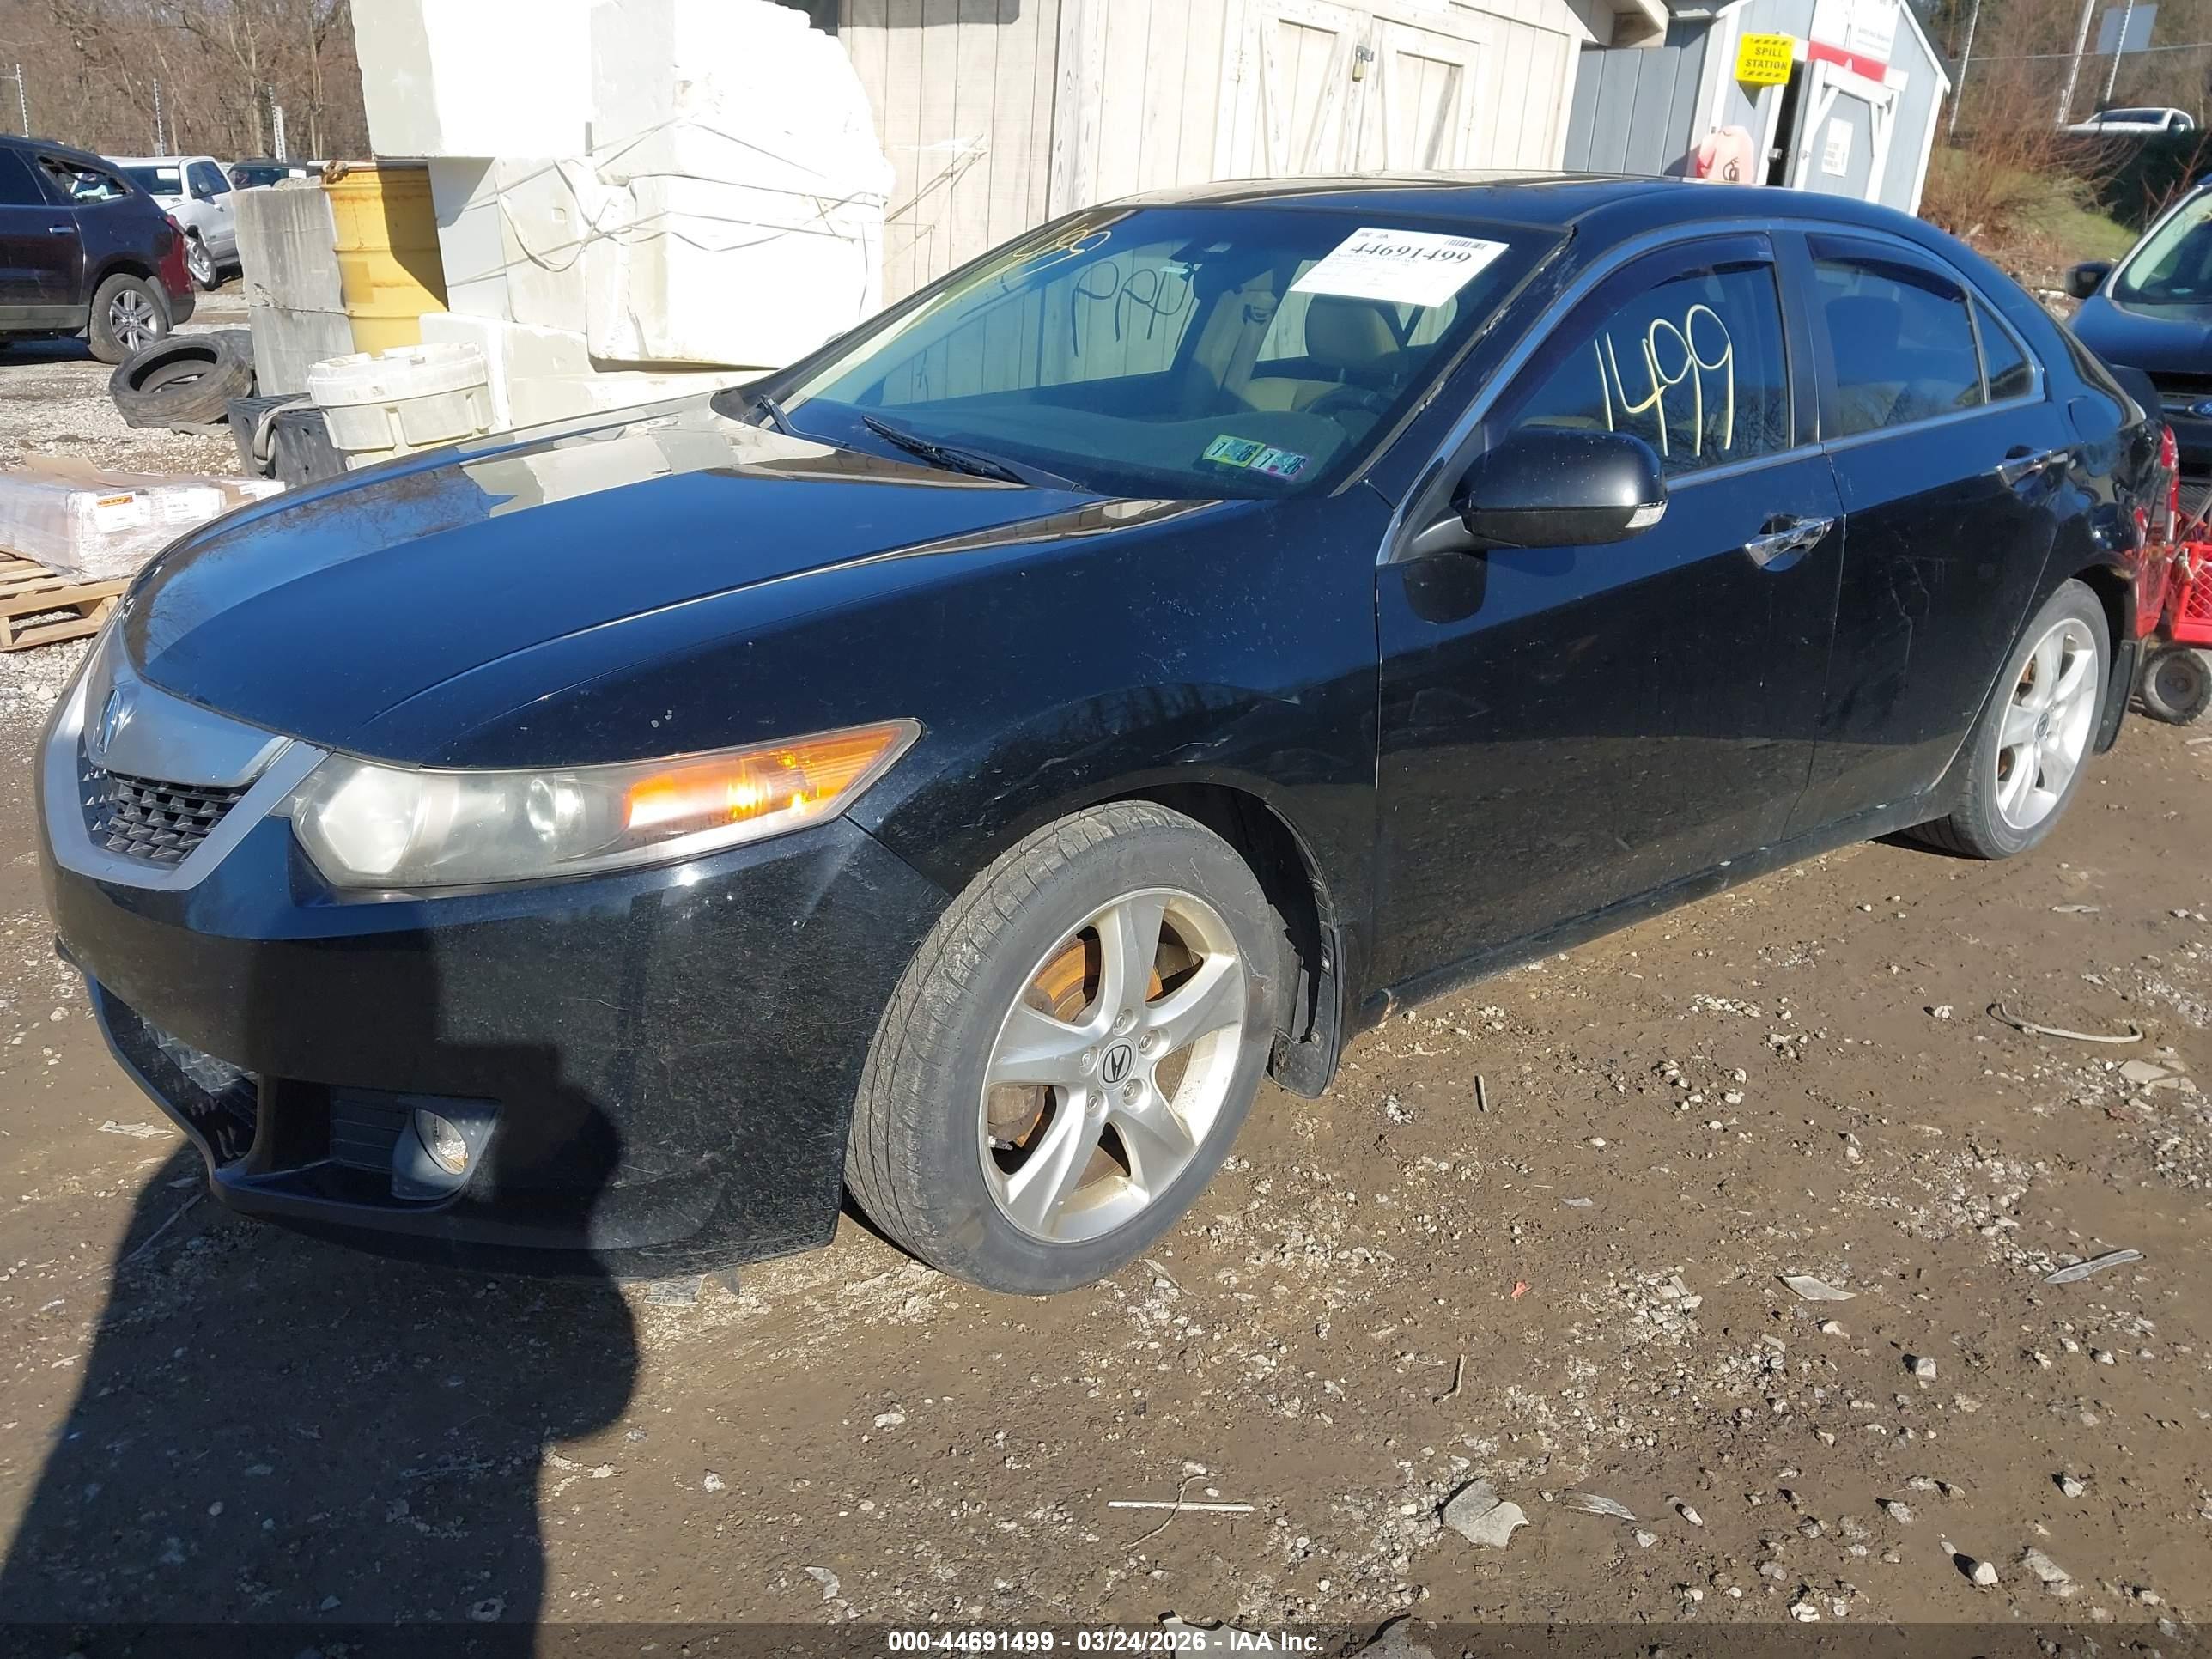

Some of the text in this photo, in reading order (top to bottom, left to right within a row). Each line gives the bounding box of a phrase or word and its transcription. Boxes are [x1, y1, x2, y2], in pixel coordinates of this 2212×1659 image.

[1754, 46, 1783, 58] SPILL
[1745, 58, 1787, 70] STATION
[1351, 242, 1473, 264] 44691499
[1595, 303, 1735, 457] 1499
